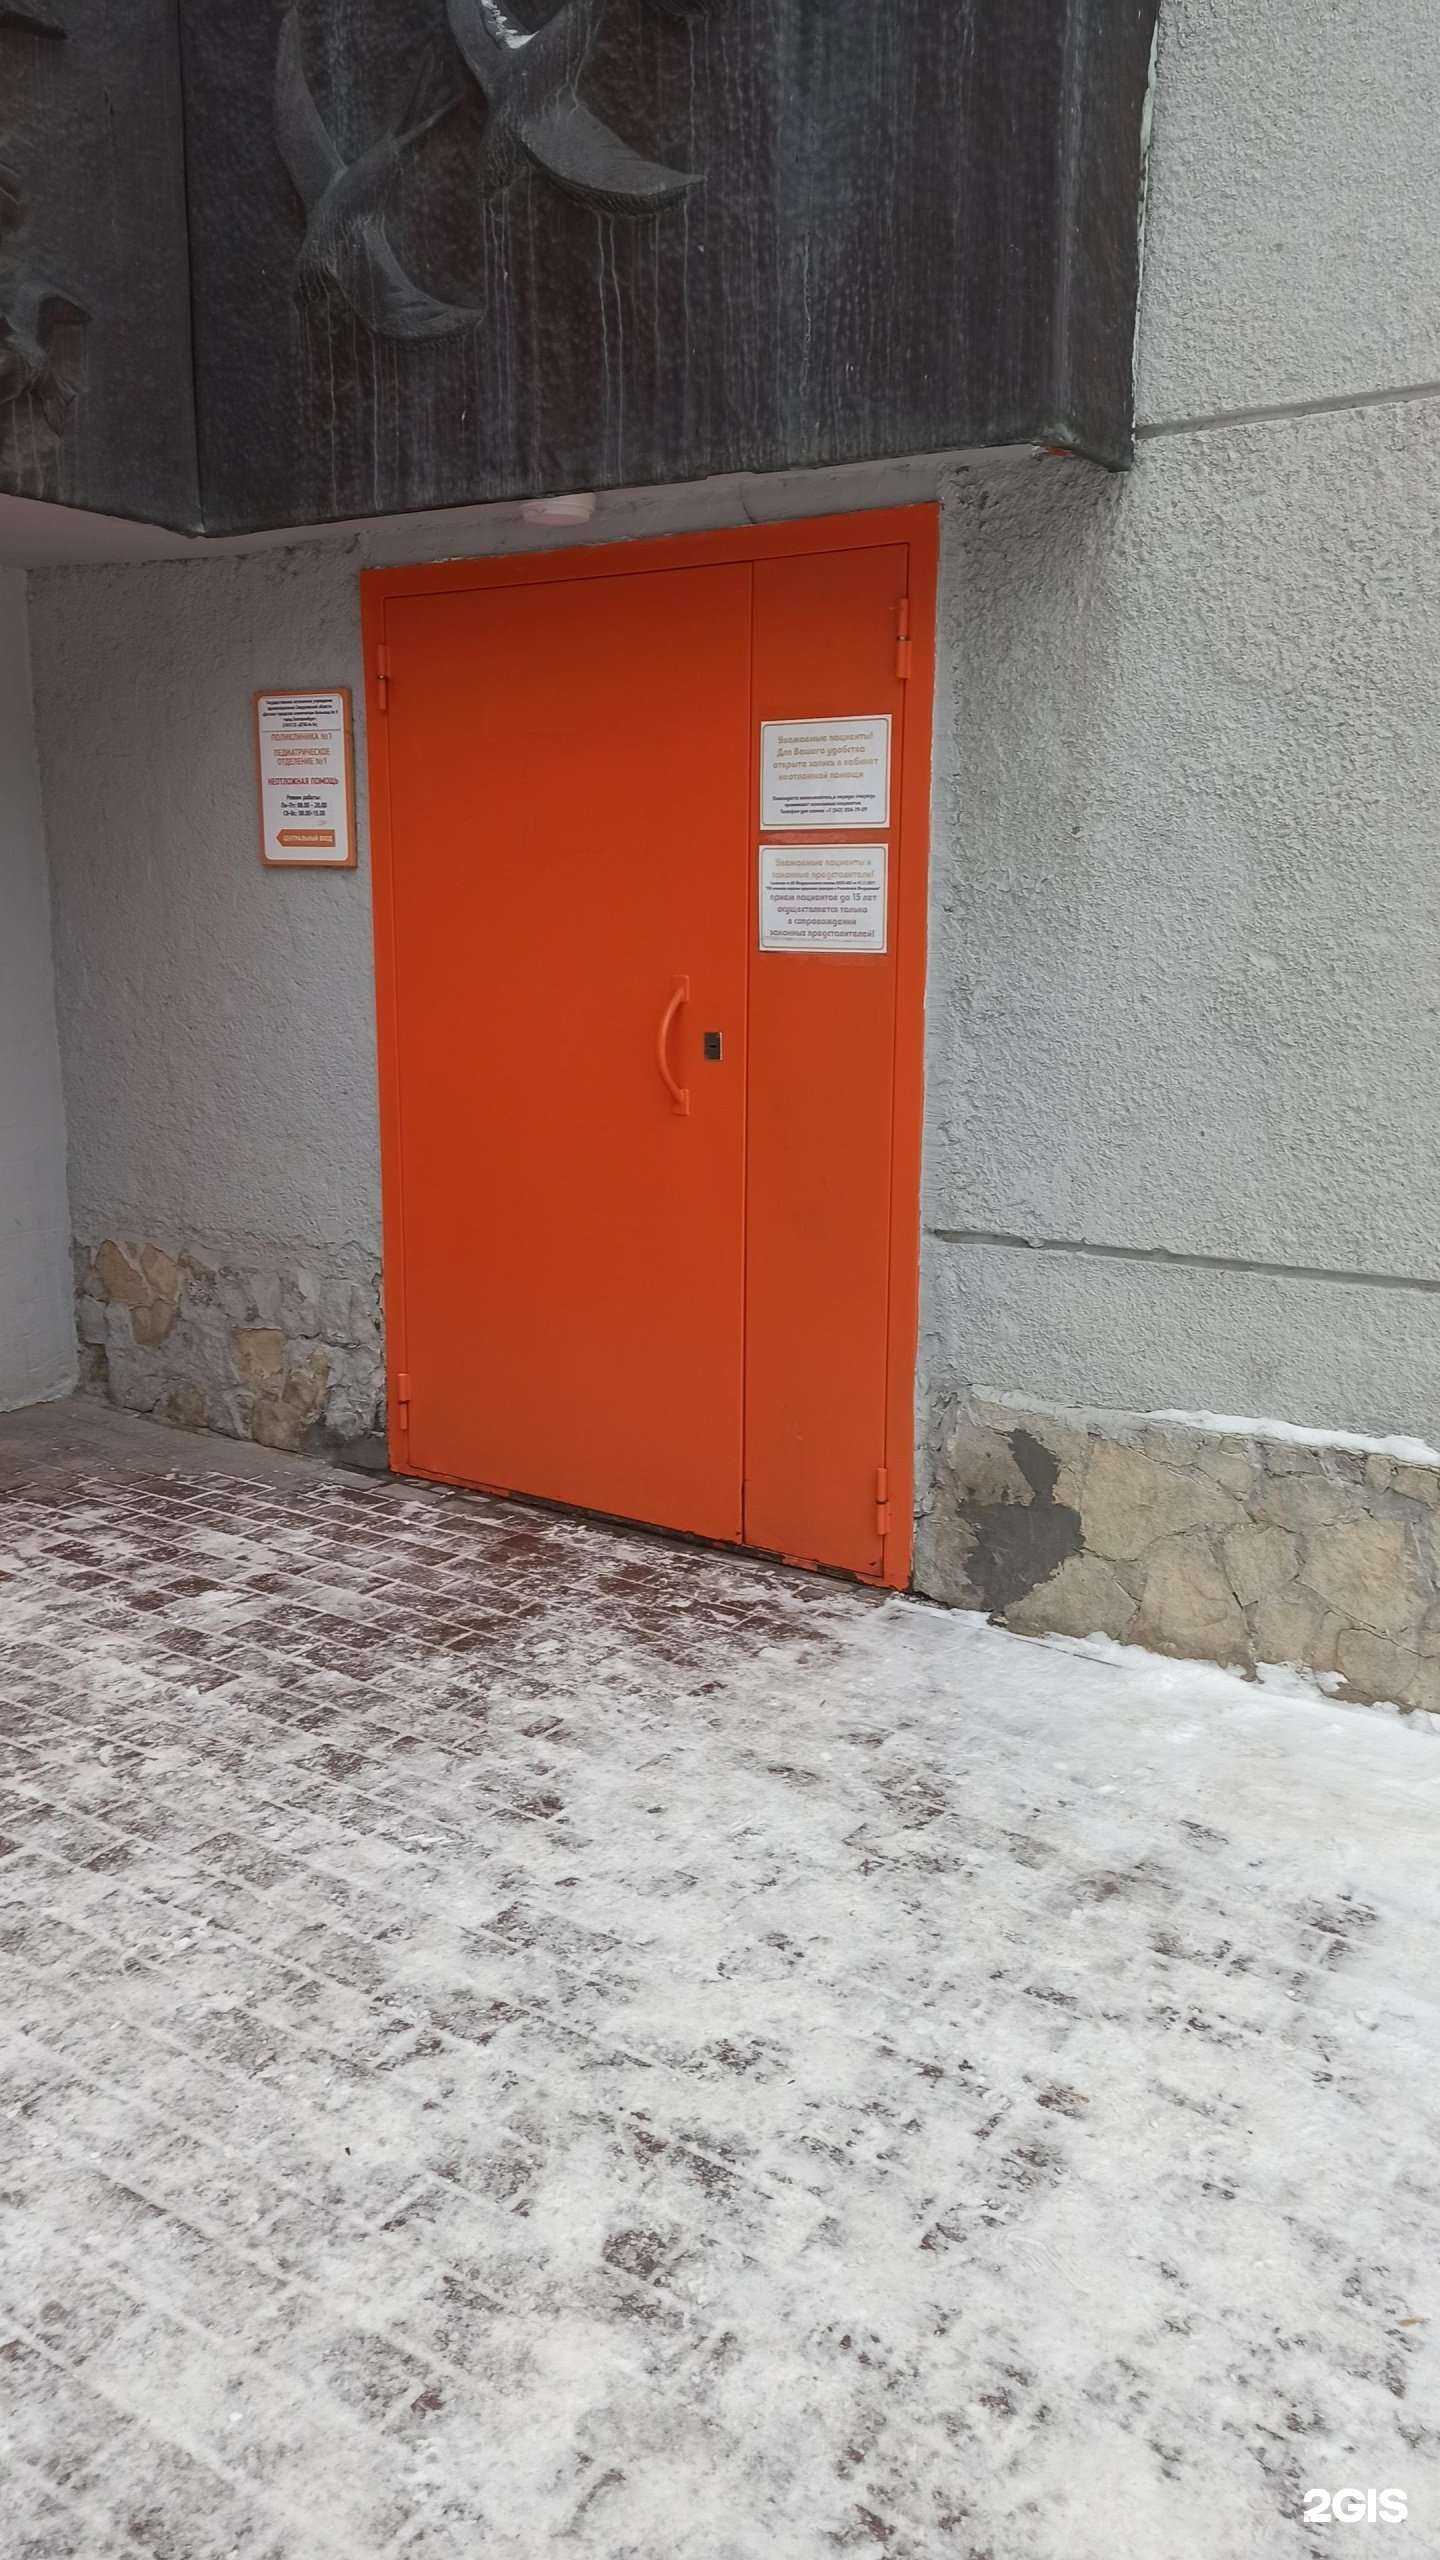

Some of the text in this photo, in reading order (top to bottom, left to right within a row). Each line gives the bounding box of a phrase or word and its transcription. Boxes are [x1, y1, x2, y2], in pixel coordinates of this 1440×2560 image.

[268, 777, 338, 786] НЕОТЛОЖНАЯ ПОМОЩЬ
[796, 894, 838, 902] пациентов
[840, 895, 850, 903] до
[852, 892, 861, 901] 15
[777, 906, 838, 915] осуществляется
